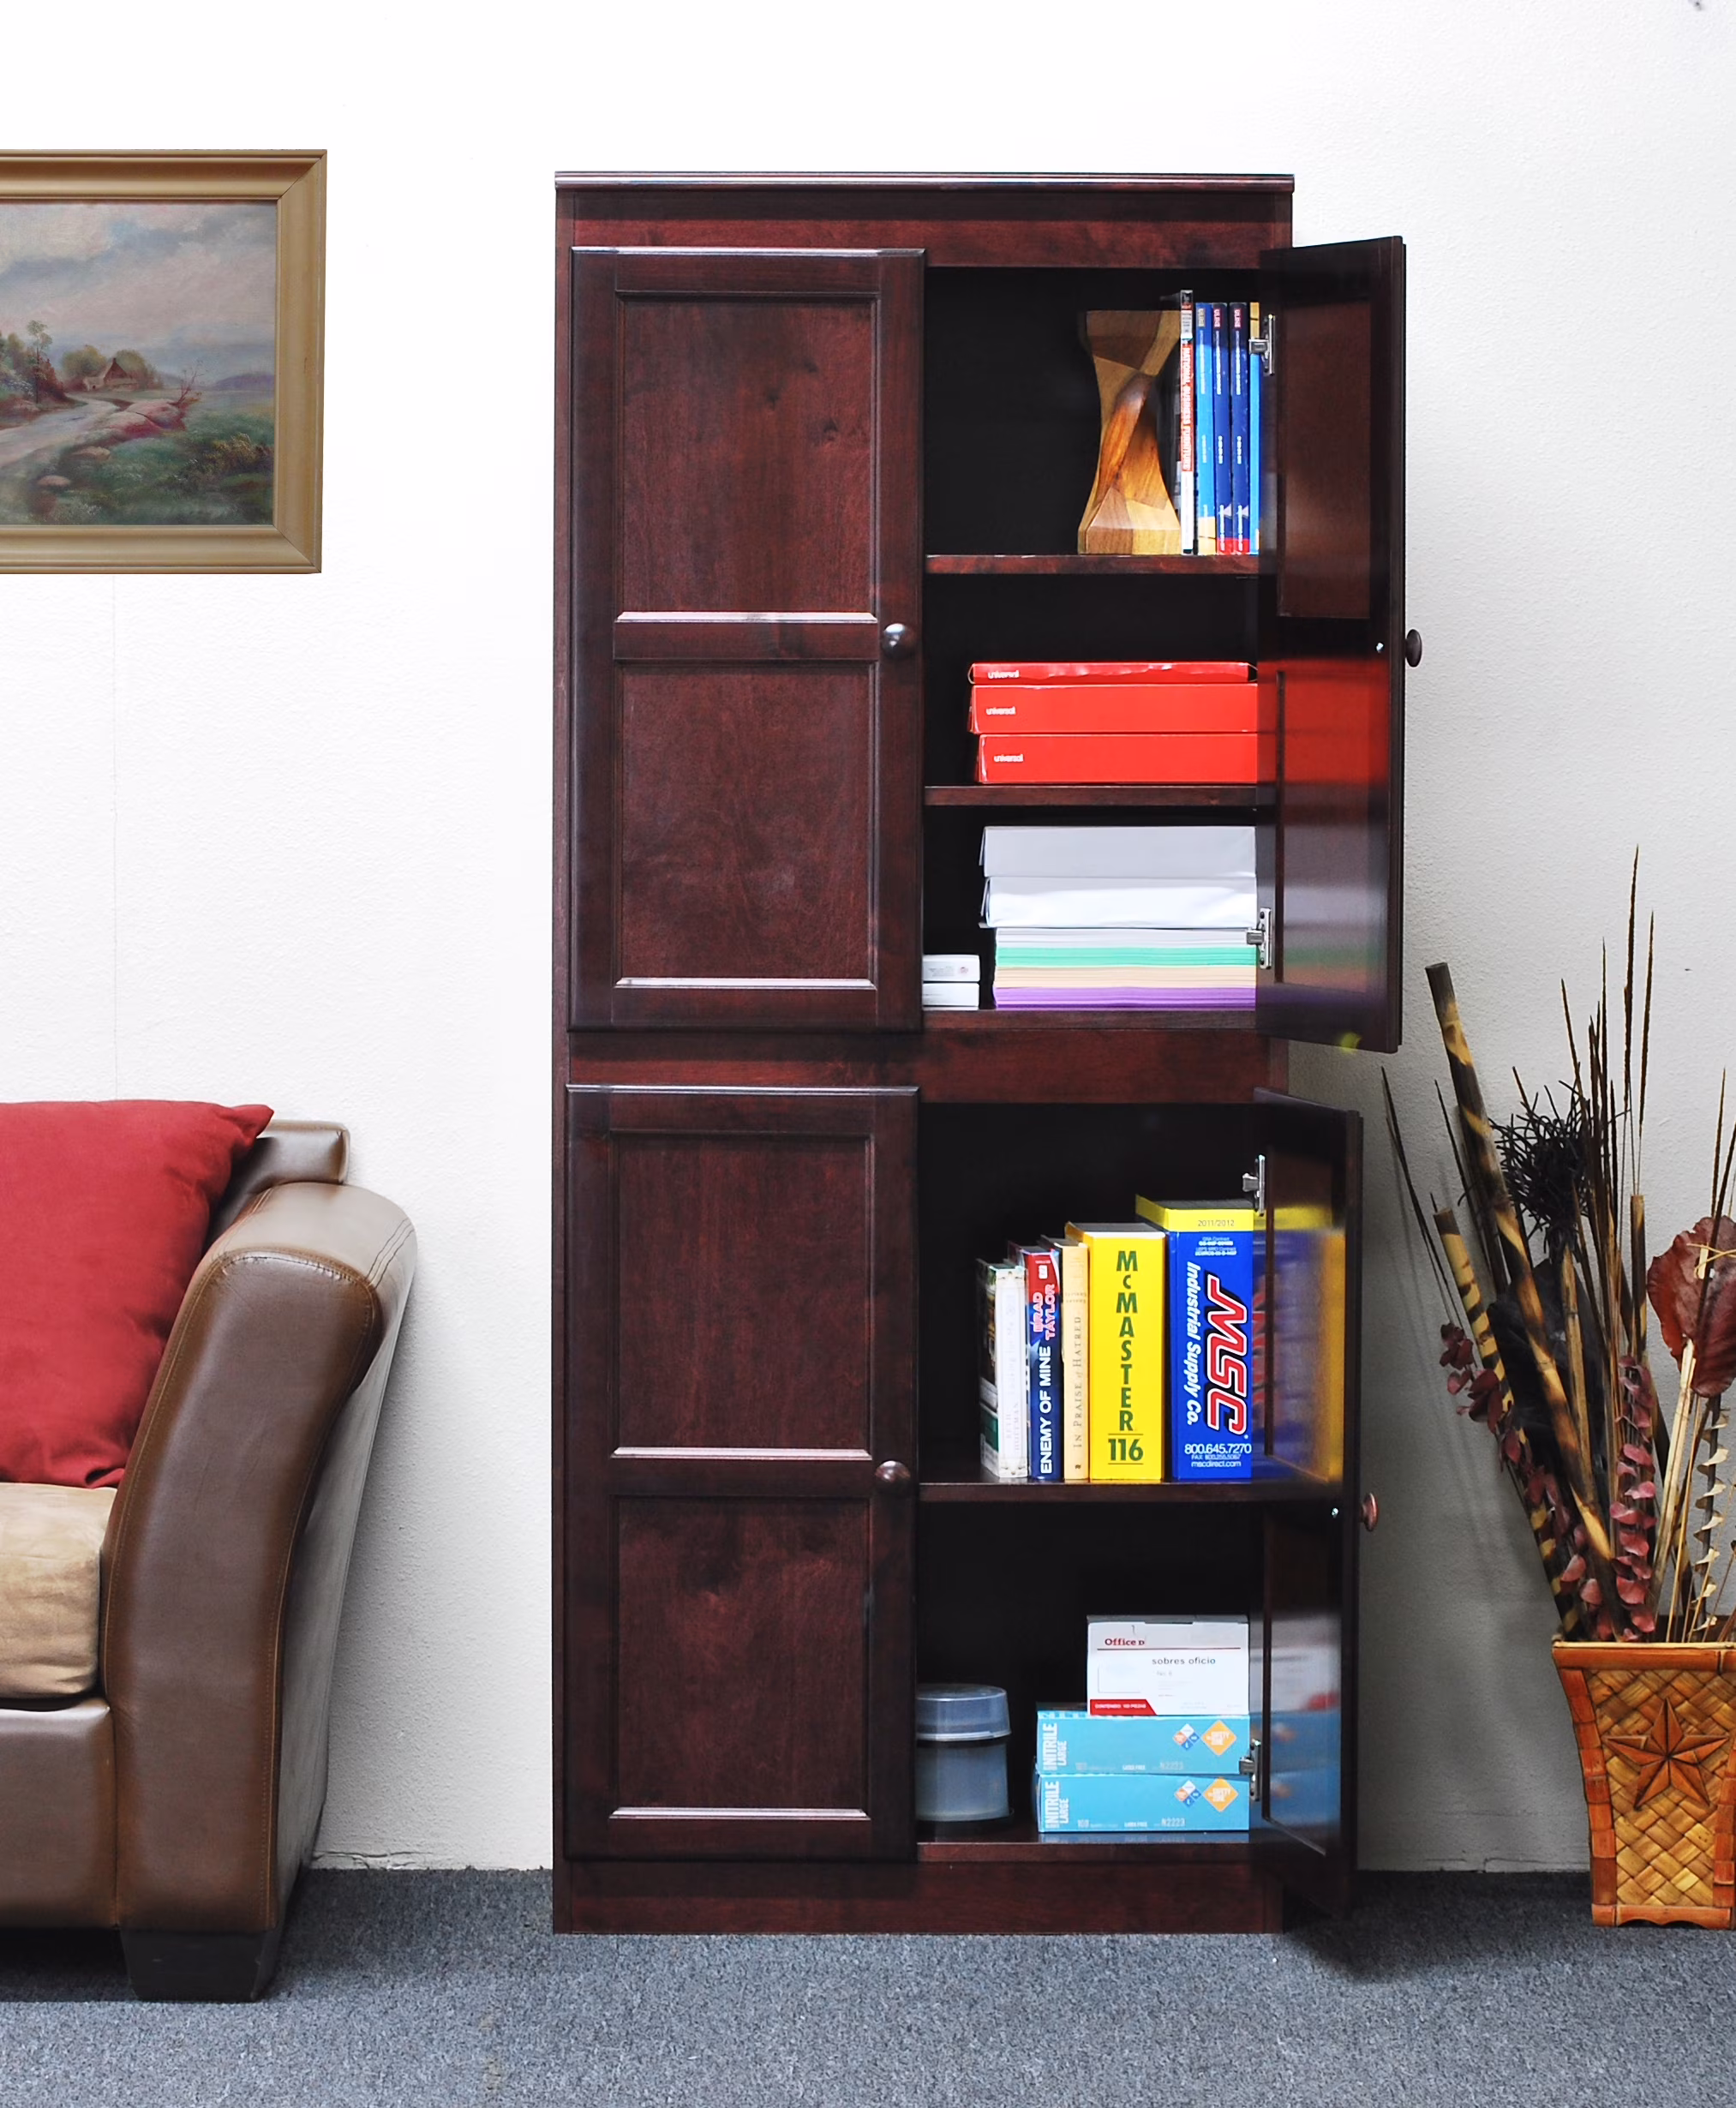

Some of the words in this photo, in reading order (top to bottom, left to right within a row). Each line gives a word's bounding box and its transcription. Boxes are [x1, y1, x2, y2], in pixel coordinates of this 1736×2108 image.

[1182, 426, 1193, 471] FURNITURE
[1197, 1219, 1235, 1227] 2011/2012
[1033, 1292, 1044, 1333] BRAD
[1045, 1284, 1056, 1341] TAYLOR
[1187, 1261, 1201, 1340] Industrial
[1072, 1316, 1082, 1368] HATRED
[1207, 1273, 1248, 1436] MSC
[1039, 1345, 1051, 1386] MINE
[1183, 1341, 1201, 1397] Supply
[1039, 1389, 1052, 1414] OF
[1073, 1382, 1082, 1428] PRAISE
[1187, 1398, 1201, 1426] Co.
[1040, 1417, 1052, 1474] ENEMY
[1073, 1434, 1082, 1448] IN
[1108, 1439, 1144, 1461] 116
[1184, 1443, 1252, 1454] 800.645.7270
[1104, 1638, 1136, 1646] Office
[1152, 1656, 1185, 1665] sobres
[1188, 1656, 1216, 1665] oficio
[1043, 1723, 1057, 1765] NITRILE
[1045, 1781, 1059, 1823] NITRILE
